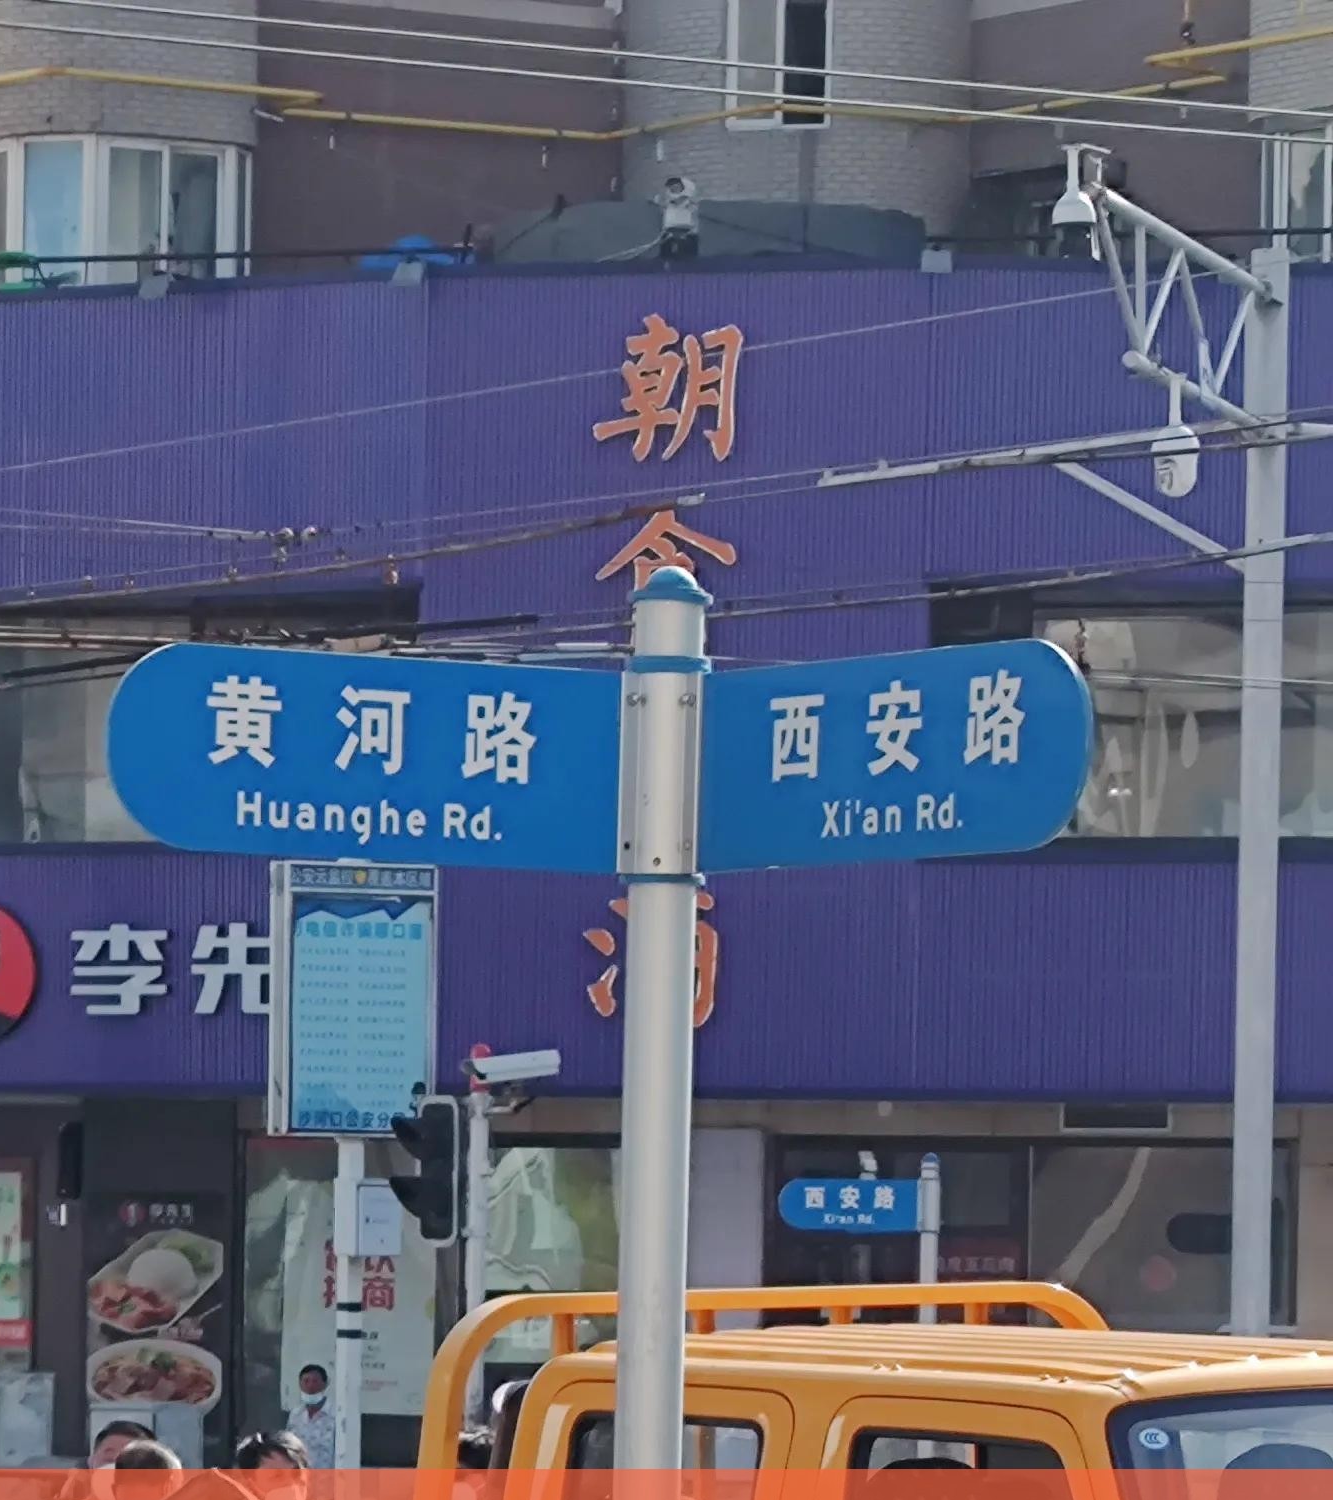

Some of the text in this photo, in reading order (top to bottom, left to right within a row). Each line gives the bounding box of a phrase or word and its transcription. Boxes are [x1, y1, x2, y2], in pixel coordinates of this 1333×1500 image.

[206, 674, 537, 786] 黄河路
[769, 668, 1027, 784] 西安路
[236, 792, 503, 846] Huanghe Rd.
[821, 794, 964, 840] Xi'an Rd.
[69, 922, 271, 1016] 李先
[803, 1185, 896, 1211] 西安路
